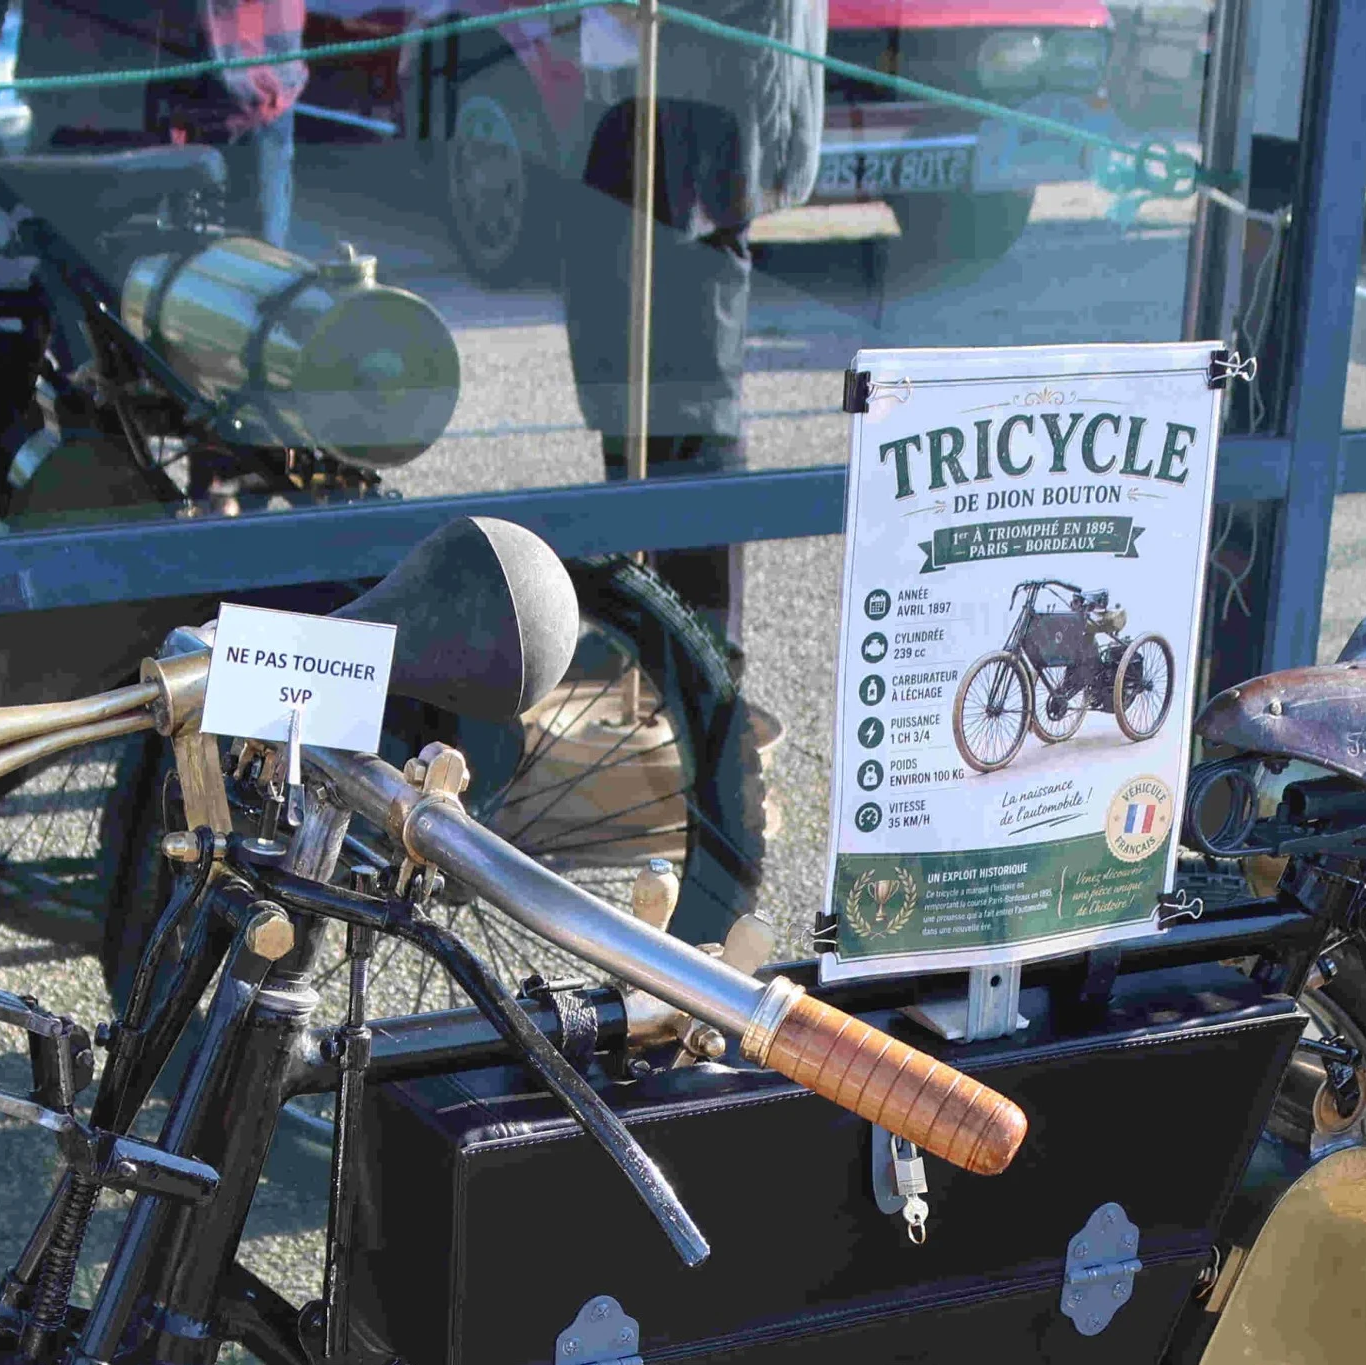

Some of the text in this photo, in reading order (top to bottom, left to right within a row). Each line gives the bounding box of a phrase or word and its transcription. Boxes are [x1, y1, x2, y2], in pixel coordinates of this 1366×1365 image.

[879, 413, 1196, 501] TRICYCLE
[953, 485, 1122, 514] DE DION BOUTON
[952, 531, 969, 546] 1er
[973, 526, 982, 542] À
[988, 519, 1059, 541] TRIOMPHÉ
[1063, 522, 1081, 535] EN
[969, 541, 1008, 558] PARIS
[1025, 536, 1096, 552] BORDEAUX
[898, 585, 929, 602] ANNÉE
[897, 602, 951, 617] AVRIL 1897
[895, 627, 944, 644] CYLINDRÉE
[894, 647, 926, 660] 239 cc
[226, 646, 376, 682] NE PAS TOUCHER
[892, 670, 958, 687] CARBURATEUR
[279, 686, 312, 705] SVP
[891, 686, 942, 702] À LÉCHAGE
[891, 714, 940, 729] PUISSANCE
[898, 732, 911, 744] CH
[913, 729, 930, 743] 3/4
[890, 758, 917, 771] POIDS
[890, 769, 965, 787] ENVIRON 100 KG
[1002, 780, 1074, 808] La naissance
[1121, 782, 1167, 805] VÉHICULE
[889, 800, 926, 814] VITESSE
[888, 814, 930, 829] 35 KM/H
[1000, 811, 1013, 826] de
[1114, 836, 1156, 855] FRANÇAIS
[927, 862, 1028, 884] UN EXPLOIT HISTORIQUE
